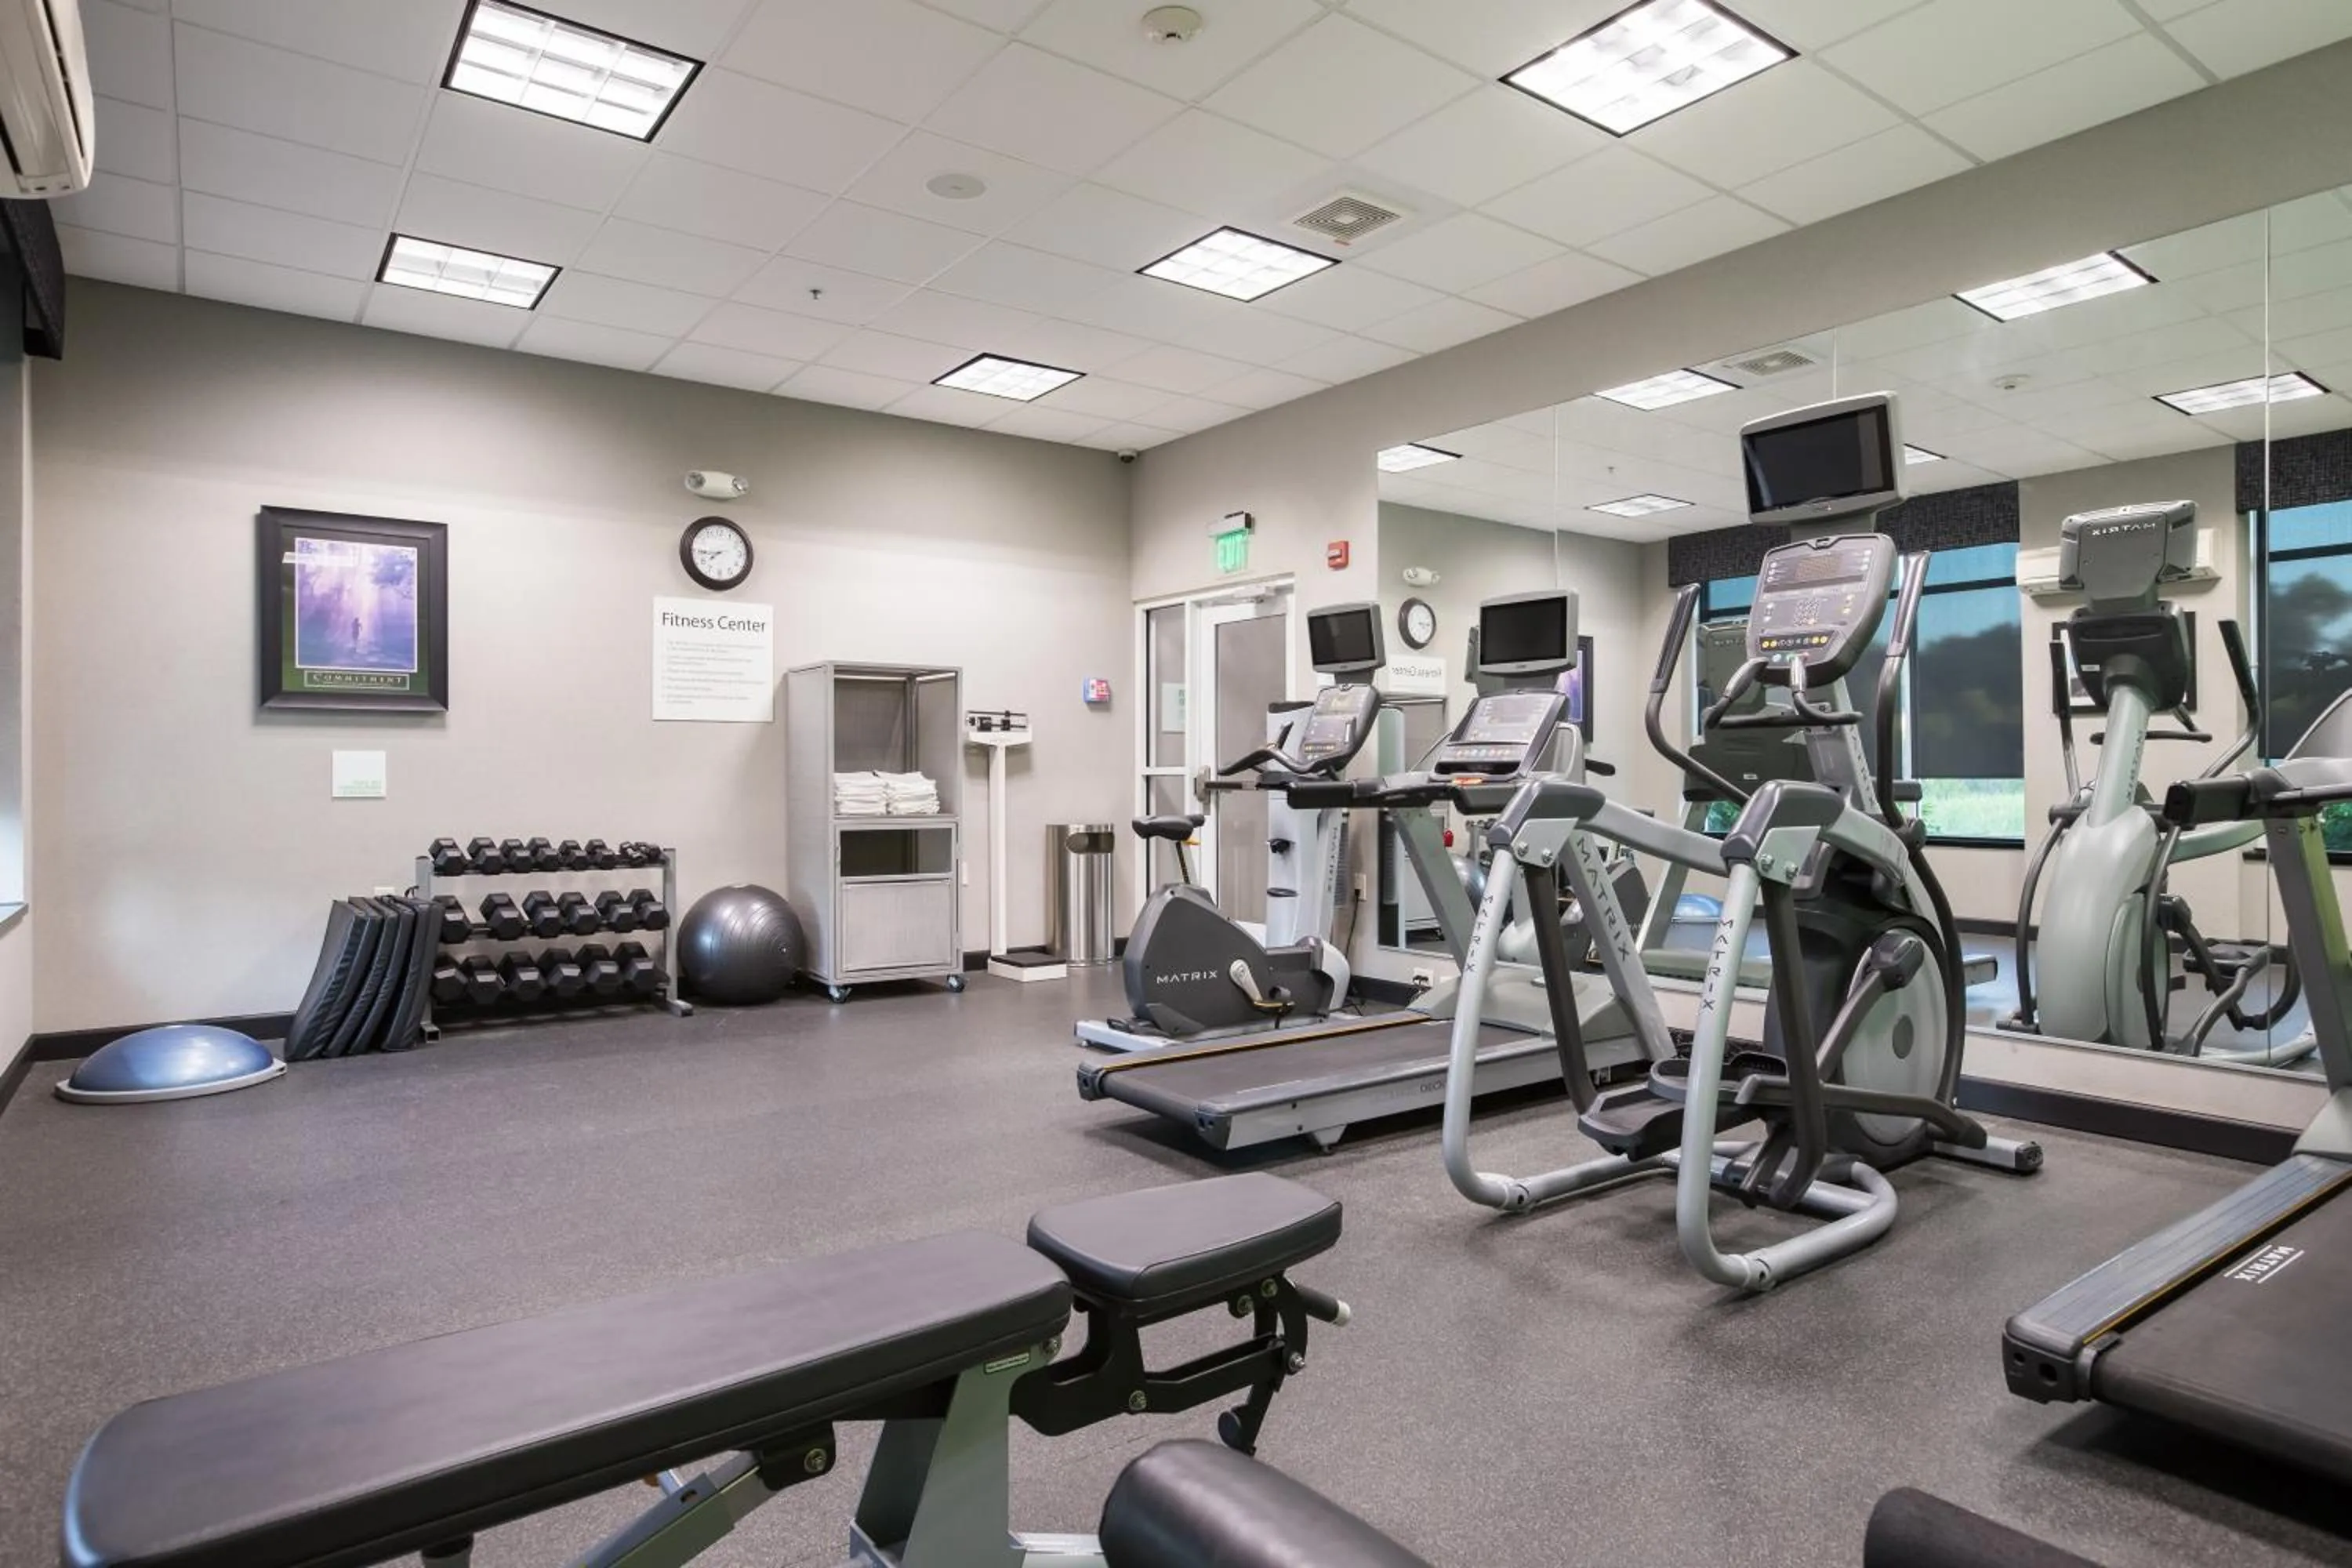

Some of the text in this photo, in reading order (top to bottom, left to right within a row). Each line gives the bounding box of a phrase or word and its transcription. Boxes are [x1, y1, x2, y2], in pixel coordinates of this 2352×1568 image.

[662, 612, 765, 632] Fitness Center
[1577, 837, 1630, 962] MATRIX
[1465, 895, 1494, 972] MATRIX
[1156, 970, 1218, 984] MATRIX
[1702, 919, 1733, 1011] MATRIX
[2234, 1246, 2295, 1282] MATRIX
